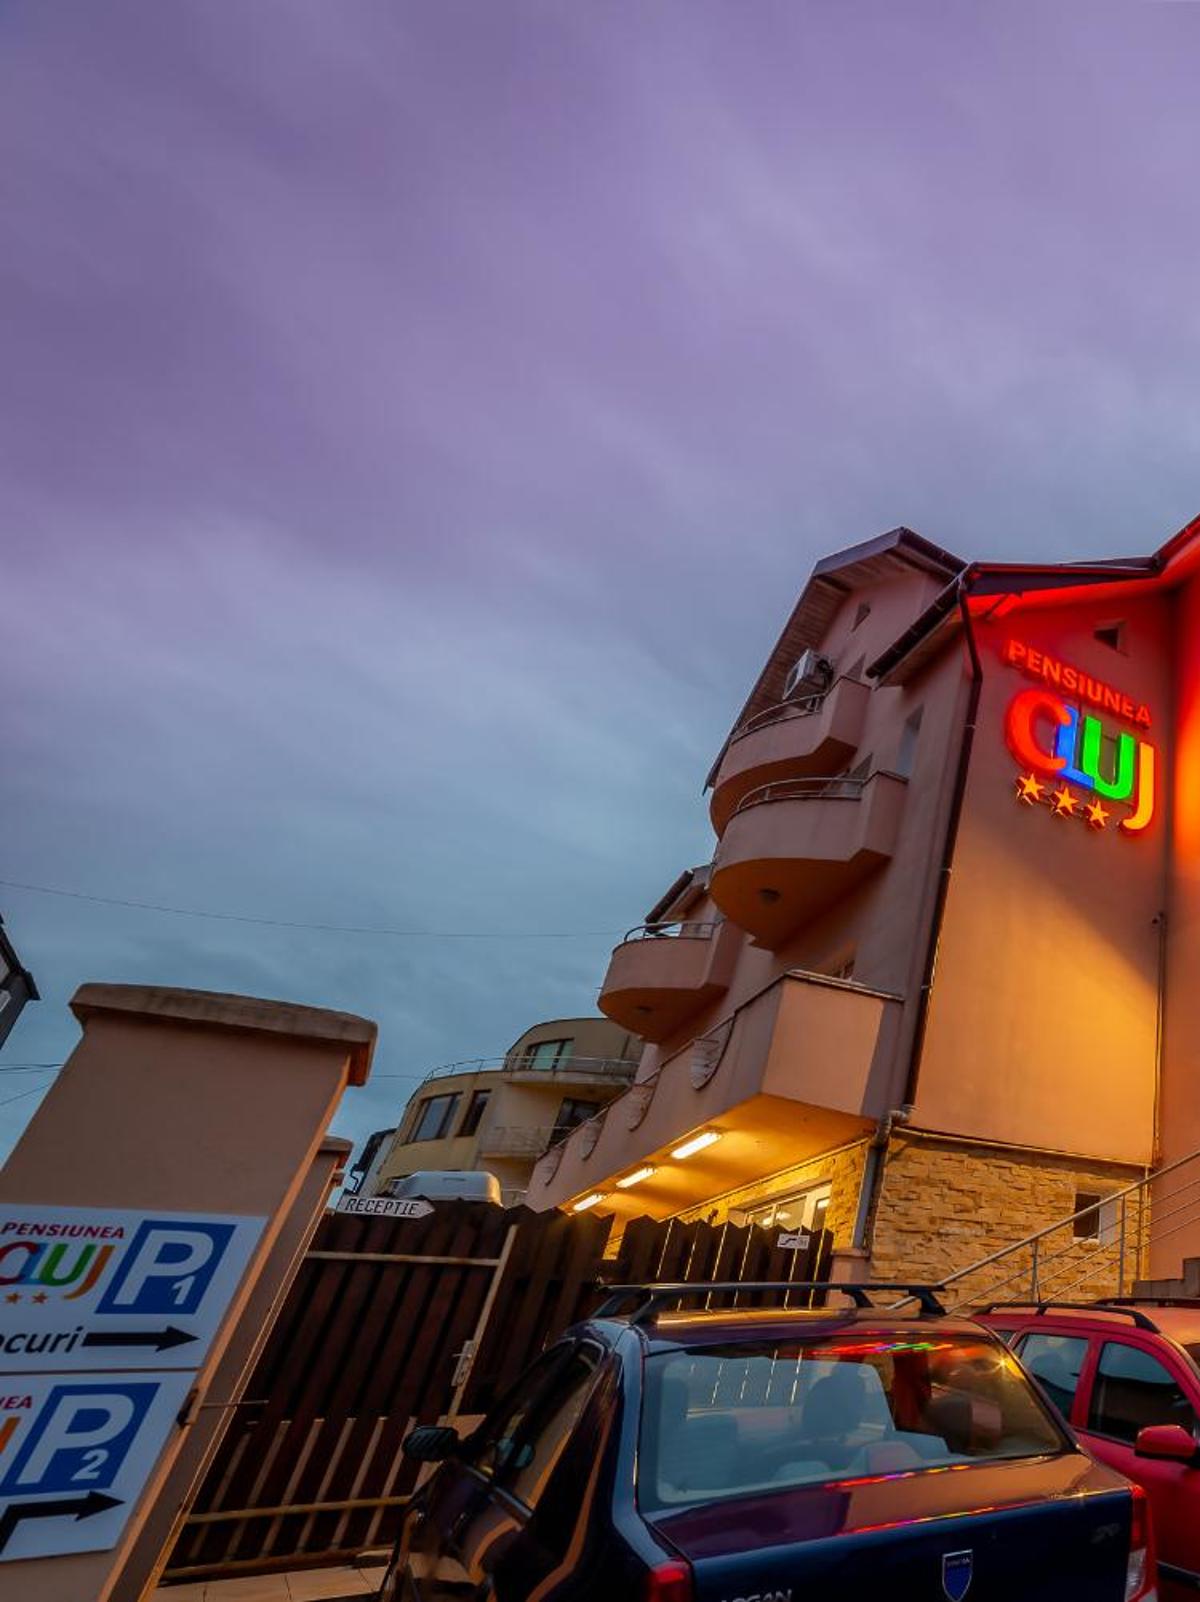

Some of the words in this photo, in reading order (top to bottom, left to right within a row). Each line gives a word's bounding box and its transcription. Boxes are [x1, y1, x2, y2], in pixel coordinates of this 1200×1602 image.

[1007, 640, 1152, 725] PENSIUNEA
[1008, 688, 1155, 830] CLUJ
[345, 1198, 420, 1216] RECEPTIE
[1, 1222, 125, 1239] PENSIUNEA
[0, 1326, 84, 1354] curi
